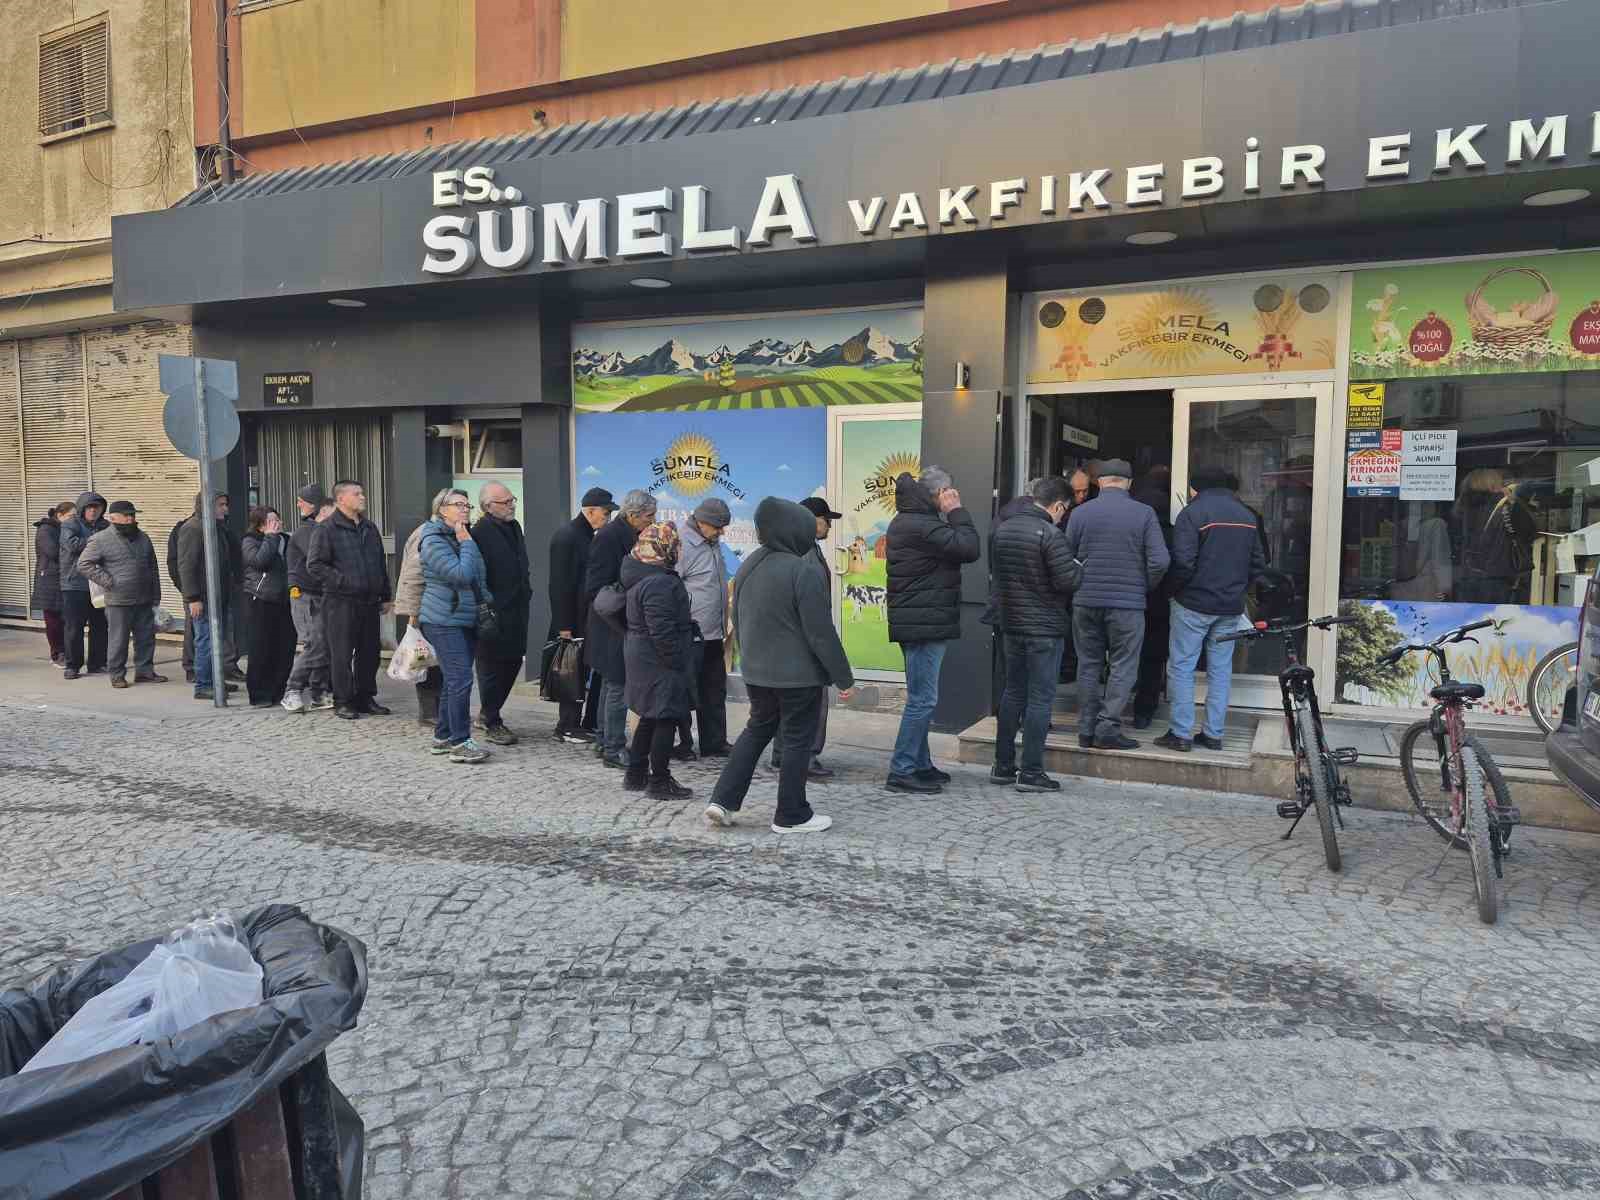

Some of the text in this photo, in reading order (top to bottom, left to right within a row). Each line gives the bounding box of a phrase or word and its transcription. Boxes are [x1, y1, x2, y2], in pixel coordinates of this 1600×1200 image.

[422, 111, 1600, 275] SÜMELA VAKFIKEBİR EKM
[1417, 329, 1442, 340] %100
[652, 455, 731, 477] SÜMELA
[648, 468, 703, 494] AKFIKEBİR
